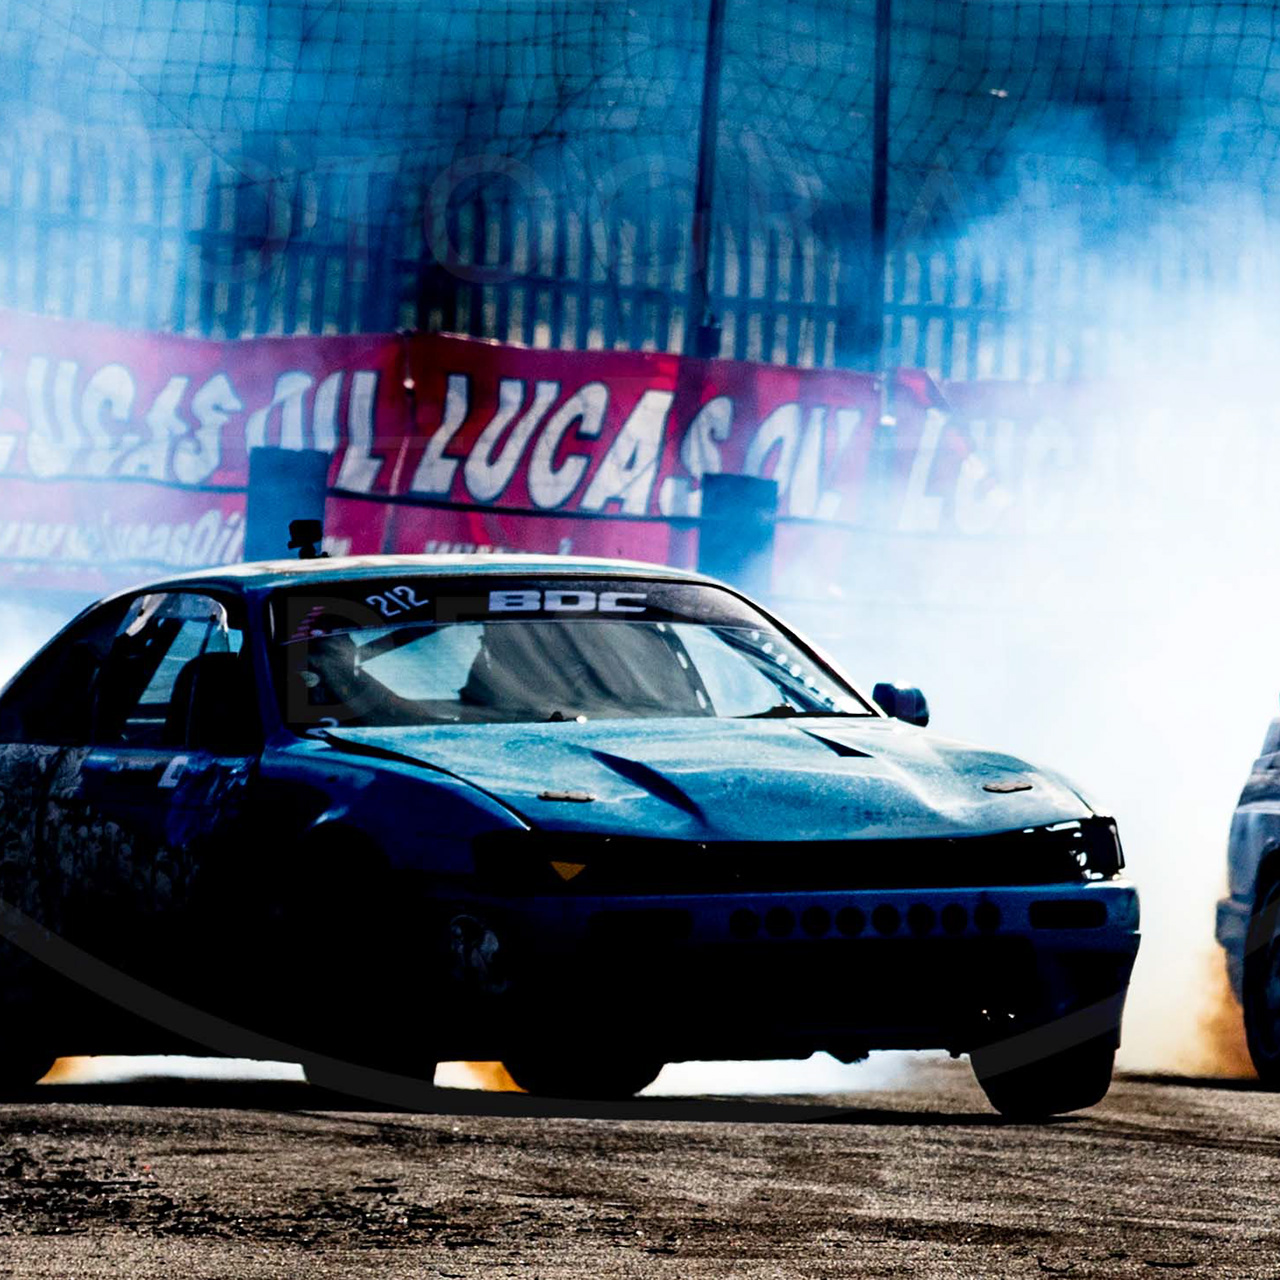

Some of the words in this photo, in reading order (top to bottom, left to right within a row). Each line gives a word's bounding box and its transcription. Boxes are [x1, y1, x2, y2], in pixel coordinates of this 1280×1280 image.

[410, 373, 733, 516] LUCAS
[743, 402, 863, 520] OIL
[365, 585, 429, 618] 212
[488, 589, 647, 613] BDC
